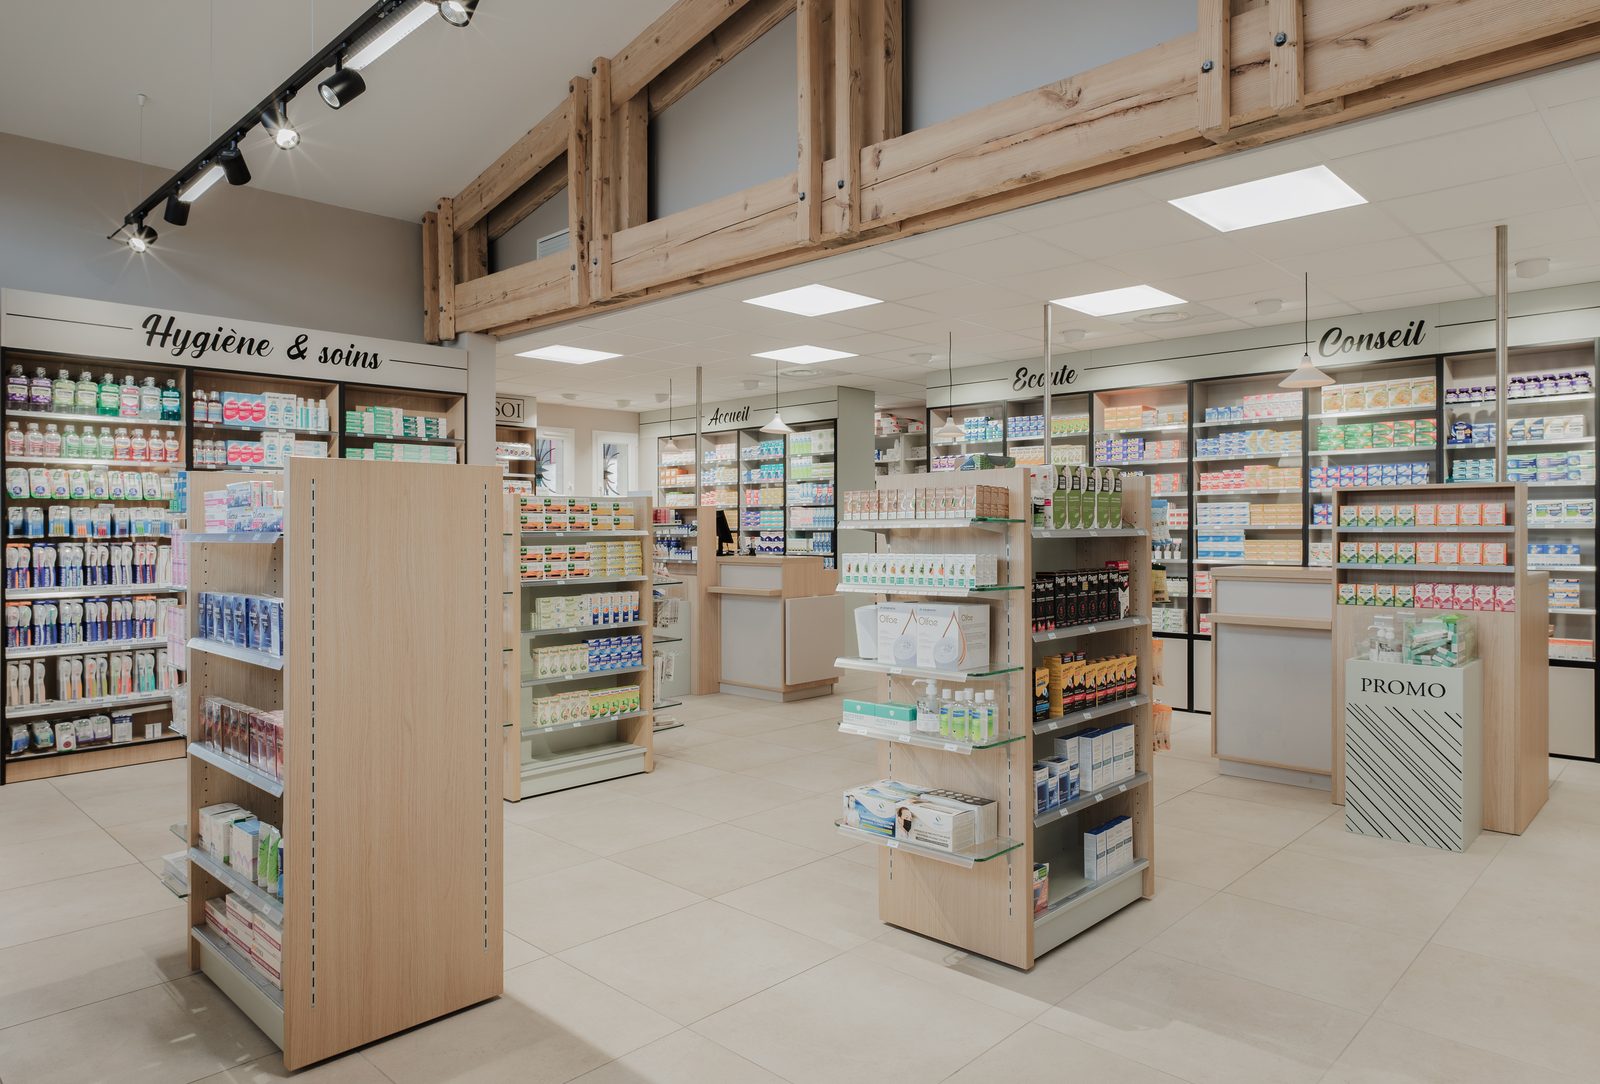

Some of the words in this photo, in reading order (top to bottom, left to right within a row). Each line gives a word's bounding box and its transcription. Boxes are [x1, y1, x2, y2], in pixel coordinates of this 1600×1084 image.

[141, 313, 273, 359] Hygiène
[286, 333, 309, 361] &
[318, 343, 383, 370] soins
[1319, 319, 1427, 358] Conseil
[1012, 364, 1078, 391] Ecoute
[707, 405, 751, 426] Accueil
[1361, 677, 1446, 699] PROMO
